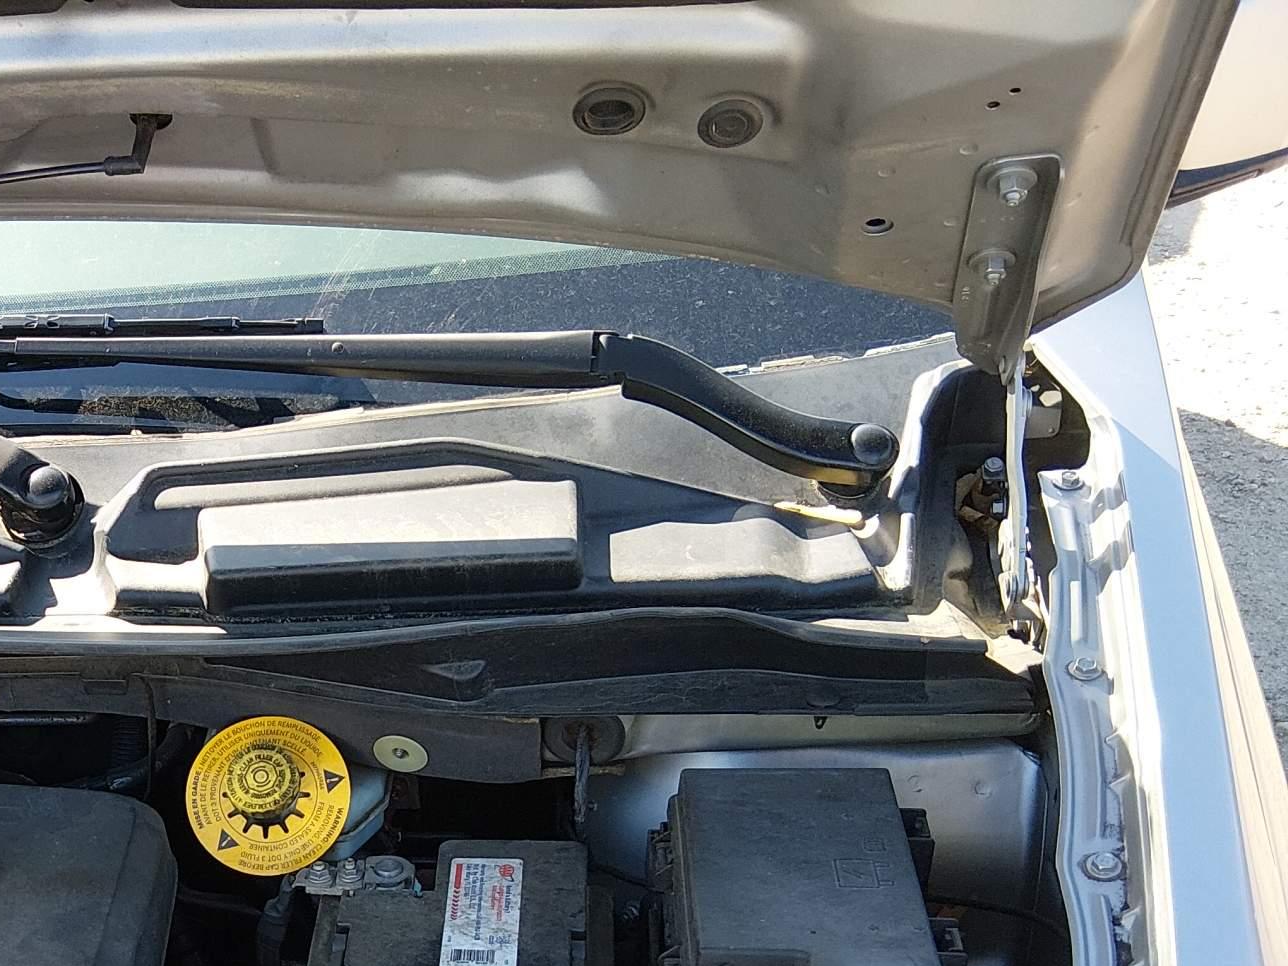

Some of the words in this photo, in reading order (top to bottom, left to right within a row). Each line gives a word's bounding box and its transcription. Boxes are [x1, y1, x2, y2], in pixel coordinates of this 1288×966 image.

[230, 721, 265, 735] BOUCHON
[242, 728, 288, 739] UNIQUEMENT
[289, 732, 300, 740] DU
[191, 770, 201, 796] GARDE
[200, 782, 206, 791] LE
[209, 761, 226, 799] PROVENANT
[191, 798, 198, 808] EN
[200, 792, 205, 801] DE
[192, 809, 204, 829] MISE
[200, 803, 212, 826] AVANT
[211, 807, 221, 822] DOT
[312, 801, 324, 822] FROM
[301, 843, 323, 860] CLEAN
